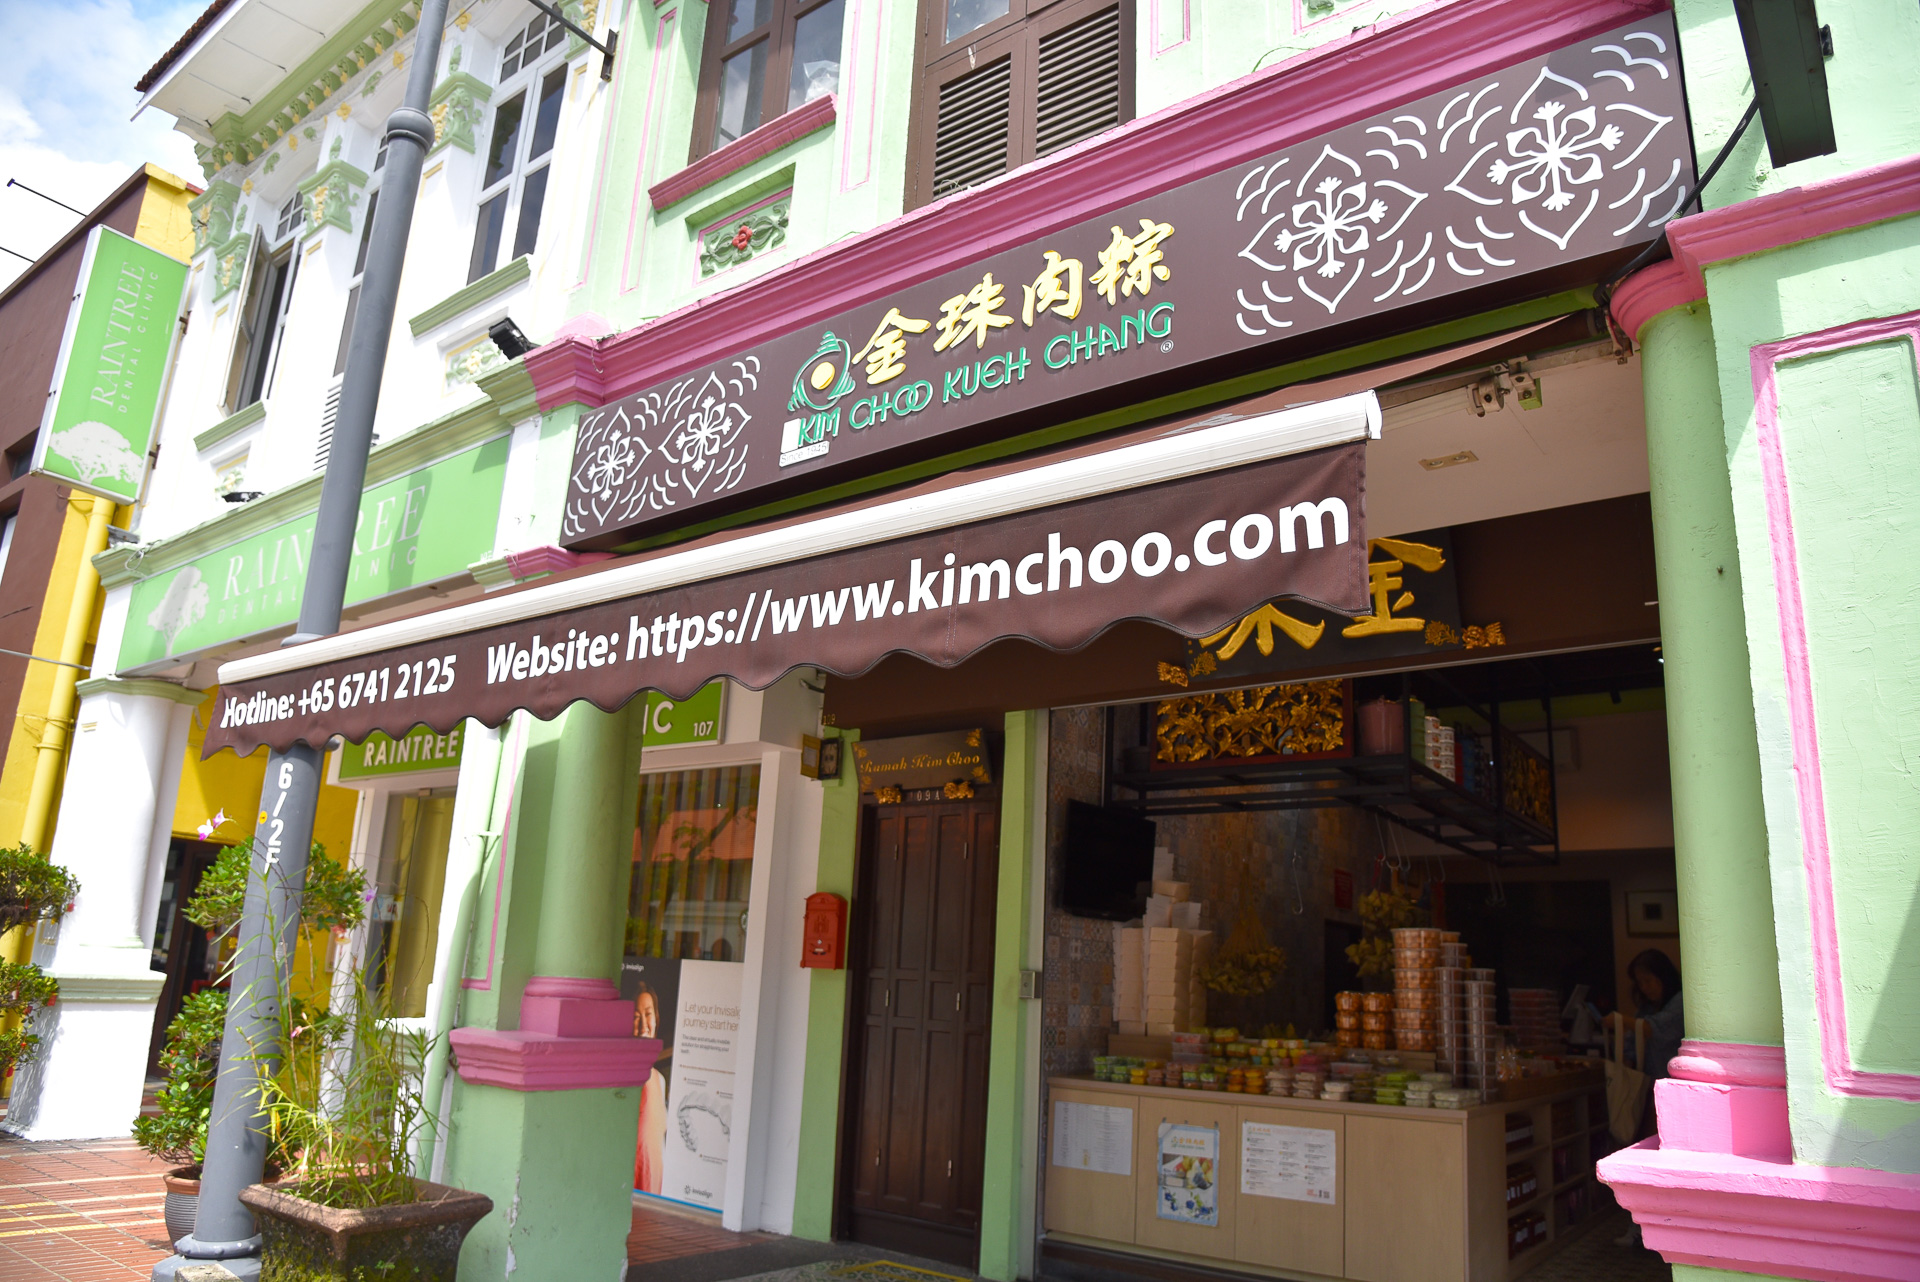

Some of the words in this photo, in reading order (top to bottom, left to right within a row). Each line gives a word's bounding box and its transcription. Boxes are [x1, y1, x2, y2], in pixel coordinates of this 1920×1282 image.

[851, 219, 1175, 386] 金珠肉粽
[90, 261, 145, 408] RAINTREE
[118, 347, 142, 413] DENTAL
[137, 271, 159, 334] CLINIC
[797, 406, 842, 447] KIM
[849, 379, 934, 430] CHOO
[942, 346, 1031, 404] KUEH
[1043, 301, 1174, 370] CHANG
[780, 450, 804, 466] Since
[806, 442, 828, 459] 1945
[218, 590, 297, 624] DENTAL
[354, 546, 417, 582] INIC
[220, 691, 294, 729] Hotline:
[297, 678, 335, 716] +65
[338, 665, 390, 709] 6741
[393, 654, 457, 700] 2125
[486, 630, 620, 685] Website:
[625, 496, 1350, 664] https://www.kimchoo.com
[642, 700, 675, 735] IC
[693, 720, 714, 737] 107
[363, 730, 460, 767] RAINTREE
[911, 754, 942, 768] Kim
[946, 751, 980, 766] Choo
[682, 1015, 709, 1031] journey
[709, 1019, 726, 1031] start
[726, 1020, 739, 1032] her
[684, 1001, 697, 1013] Let
[697, 1004, 713, 1016] your
